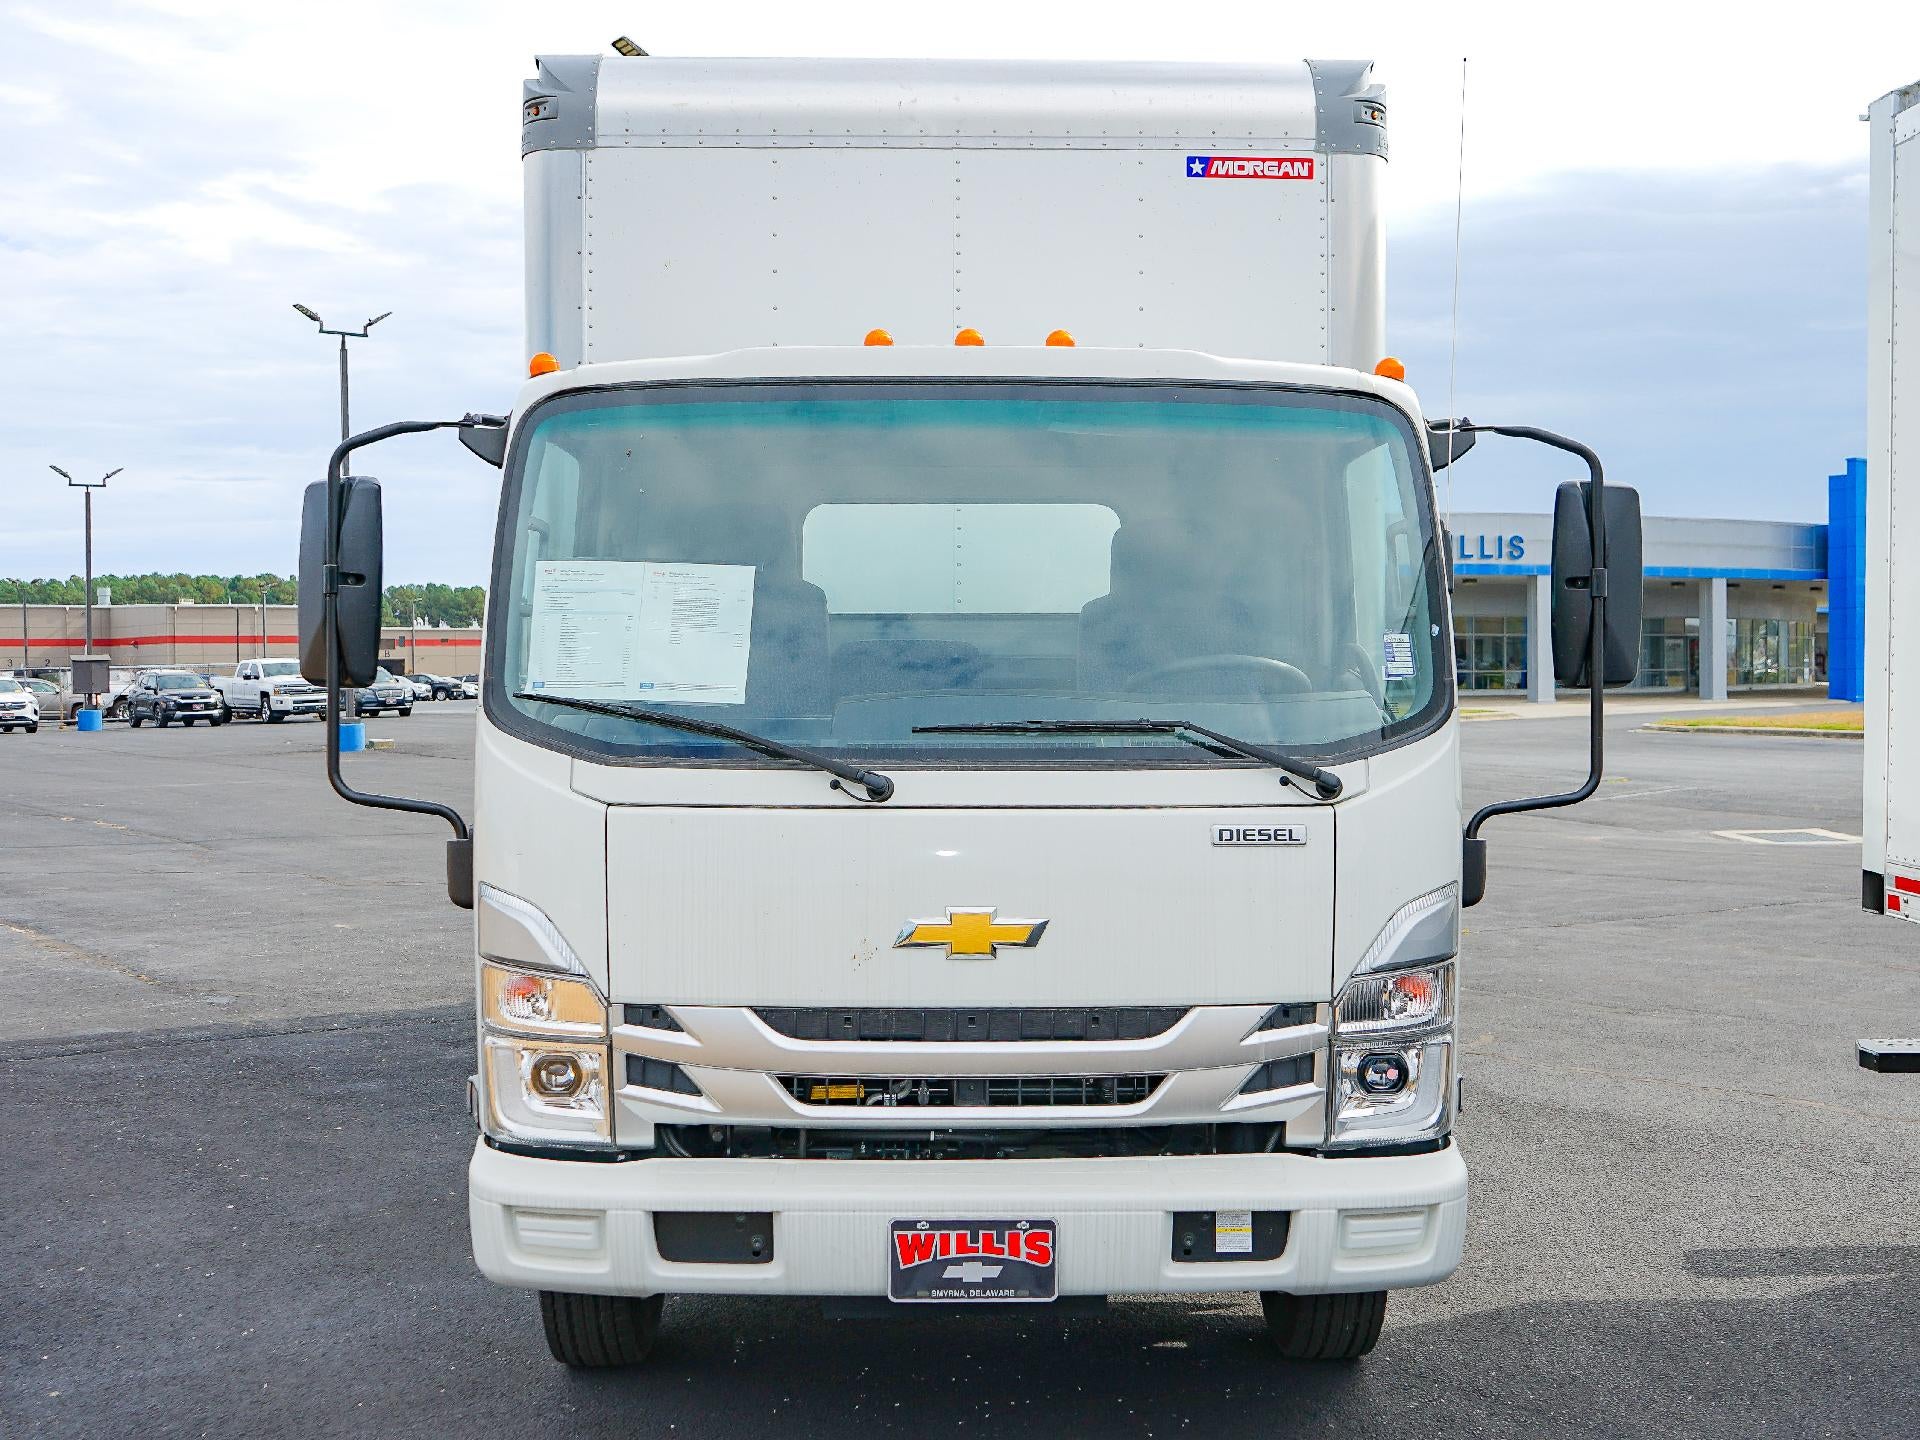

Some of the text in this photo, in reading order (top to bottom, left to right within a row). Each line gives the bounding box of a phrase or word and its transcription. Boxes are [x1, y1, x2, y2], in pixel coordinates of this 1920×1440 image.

[1210, 160, 1309, 177] MORGAN
[1218, 828, 1301, 842] DIESEL
[893, 1229, 1053, 1270] WILLIS
[931, 1289, 1015, 1298] SMYRNA, DELAWARE
